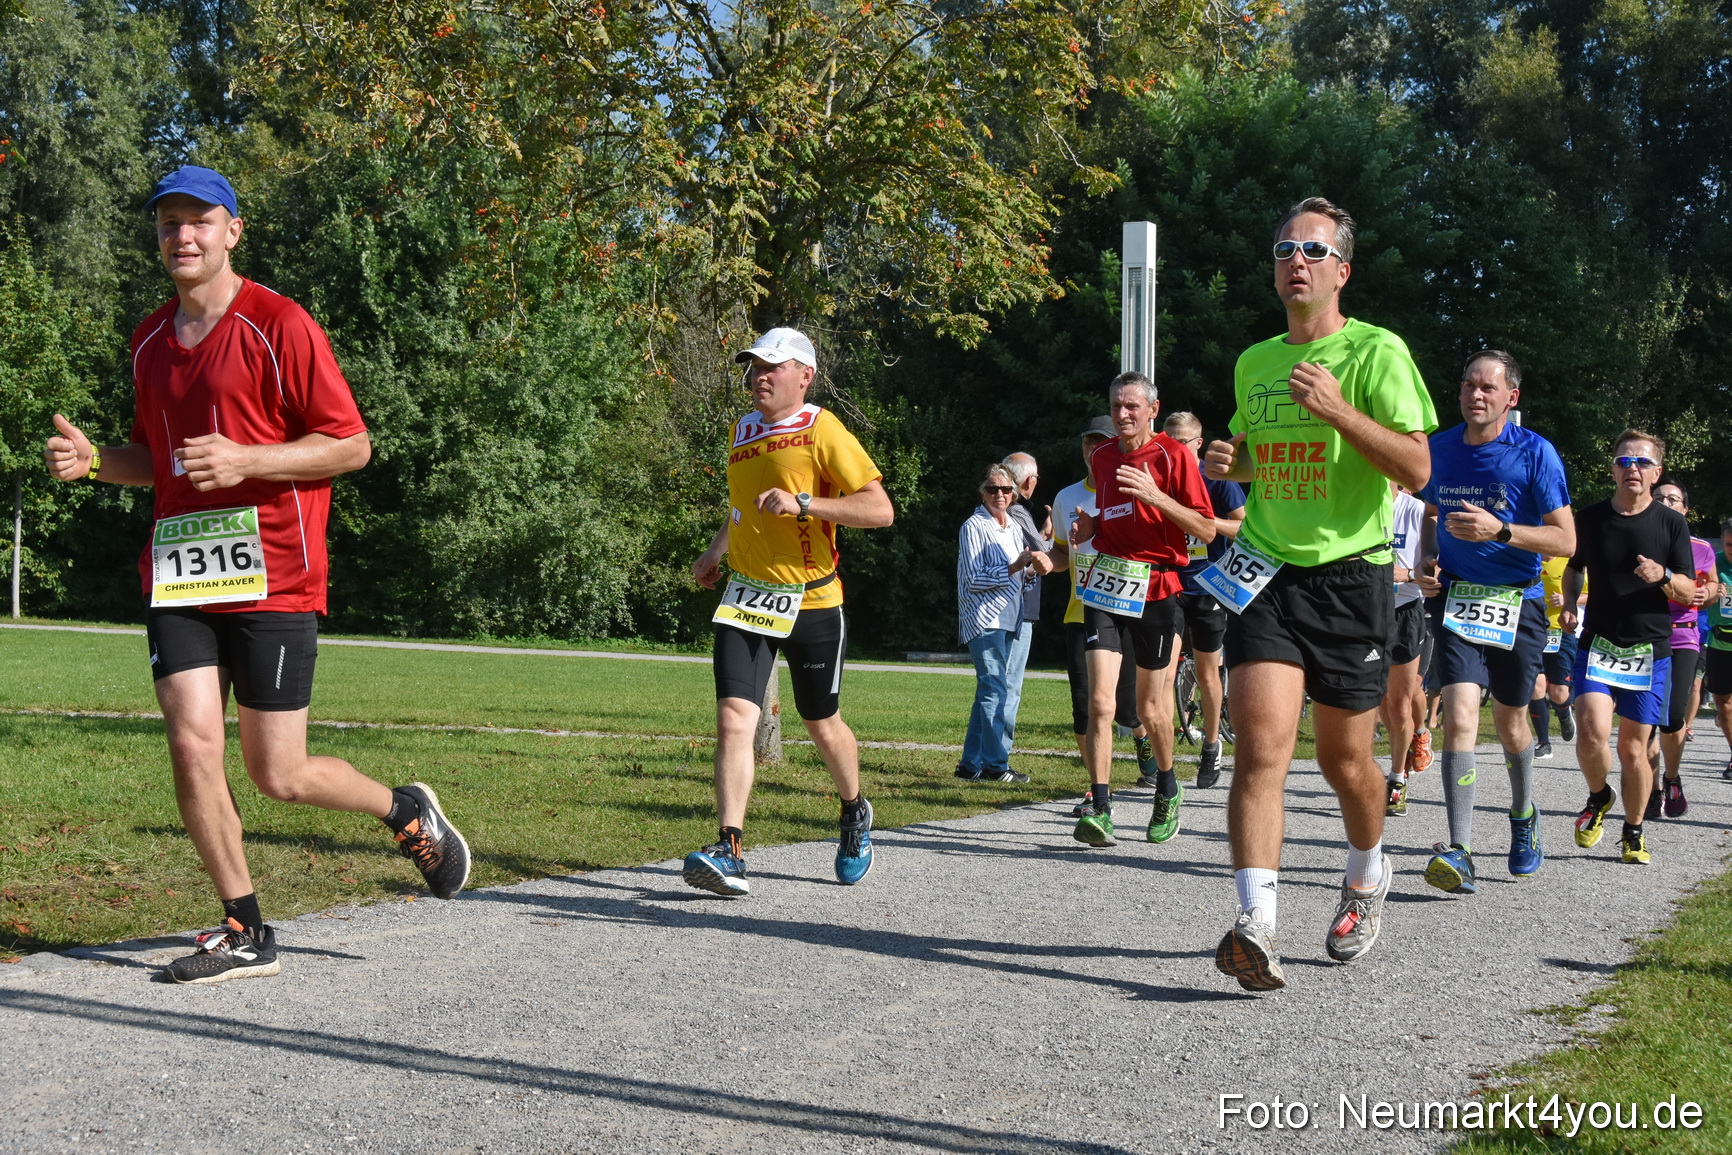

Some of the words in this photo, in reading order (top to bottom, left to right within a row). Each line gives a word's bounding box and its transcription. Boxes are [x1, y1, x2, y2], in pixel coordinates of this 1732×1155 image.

[729, 445, 761, 466] MAX
[766, 434, 814, 453] BÖGL
[1256, 442, 1326, 465] MERZ
[1255, 465, 1326, 482] PREMIUM
[1439, 485, 1483, 495] Kirwaläufer
[1111, 507, 1126, 515] DEHN
[161, 513, 248, 541] BOCK
[167, 542, 252, 577] 1316
[1098, 557, 1144, 577] BOCK
[165, 581, 219, 592] CHRISTIAN
[221, 577, 255, 588] XAVER
[1093, 572, 1140, 597] 2577
[1455, 584, 1515, 603] BOCK
[735, 586, 791, 614] 1240
[1094, 594, 1130, 609] MARTIN
[734, 612, 774, 628] ANTON
[1453, 603, 1509, 627] 2553
[1596, 652, 1645, 672] 2757
